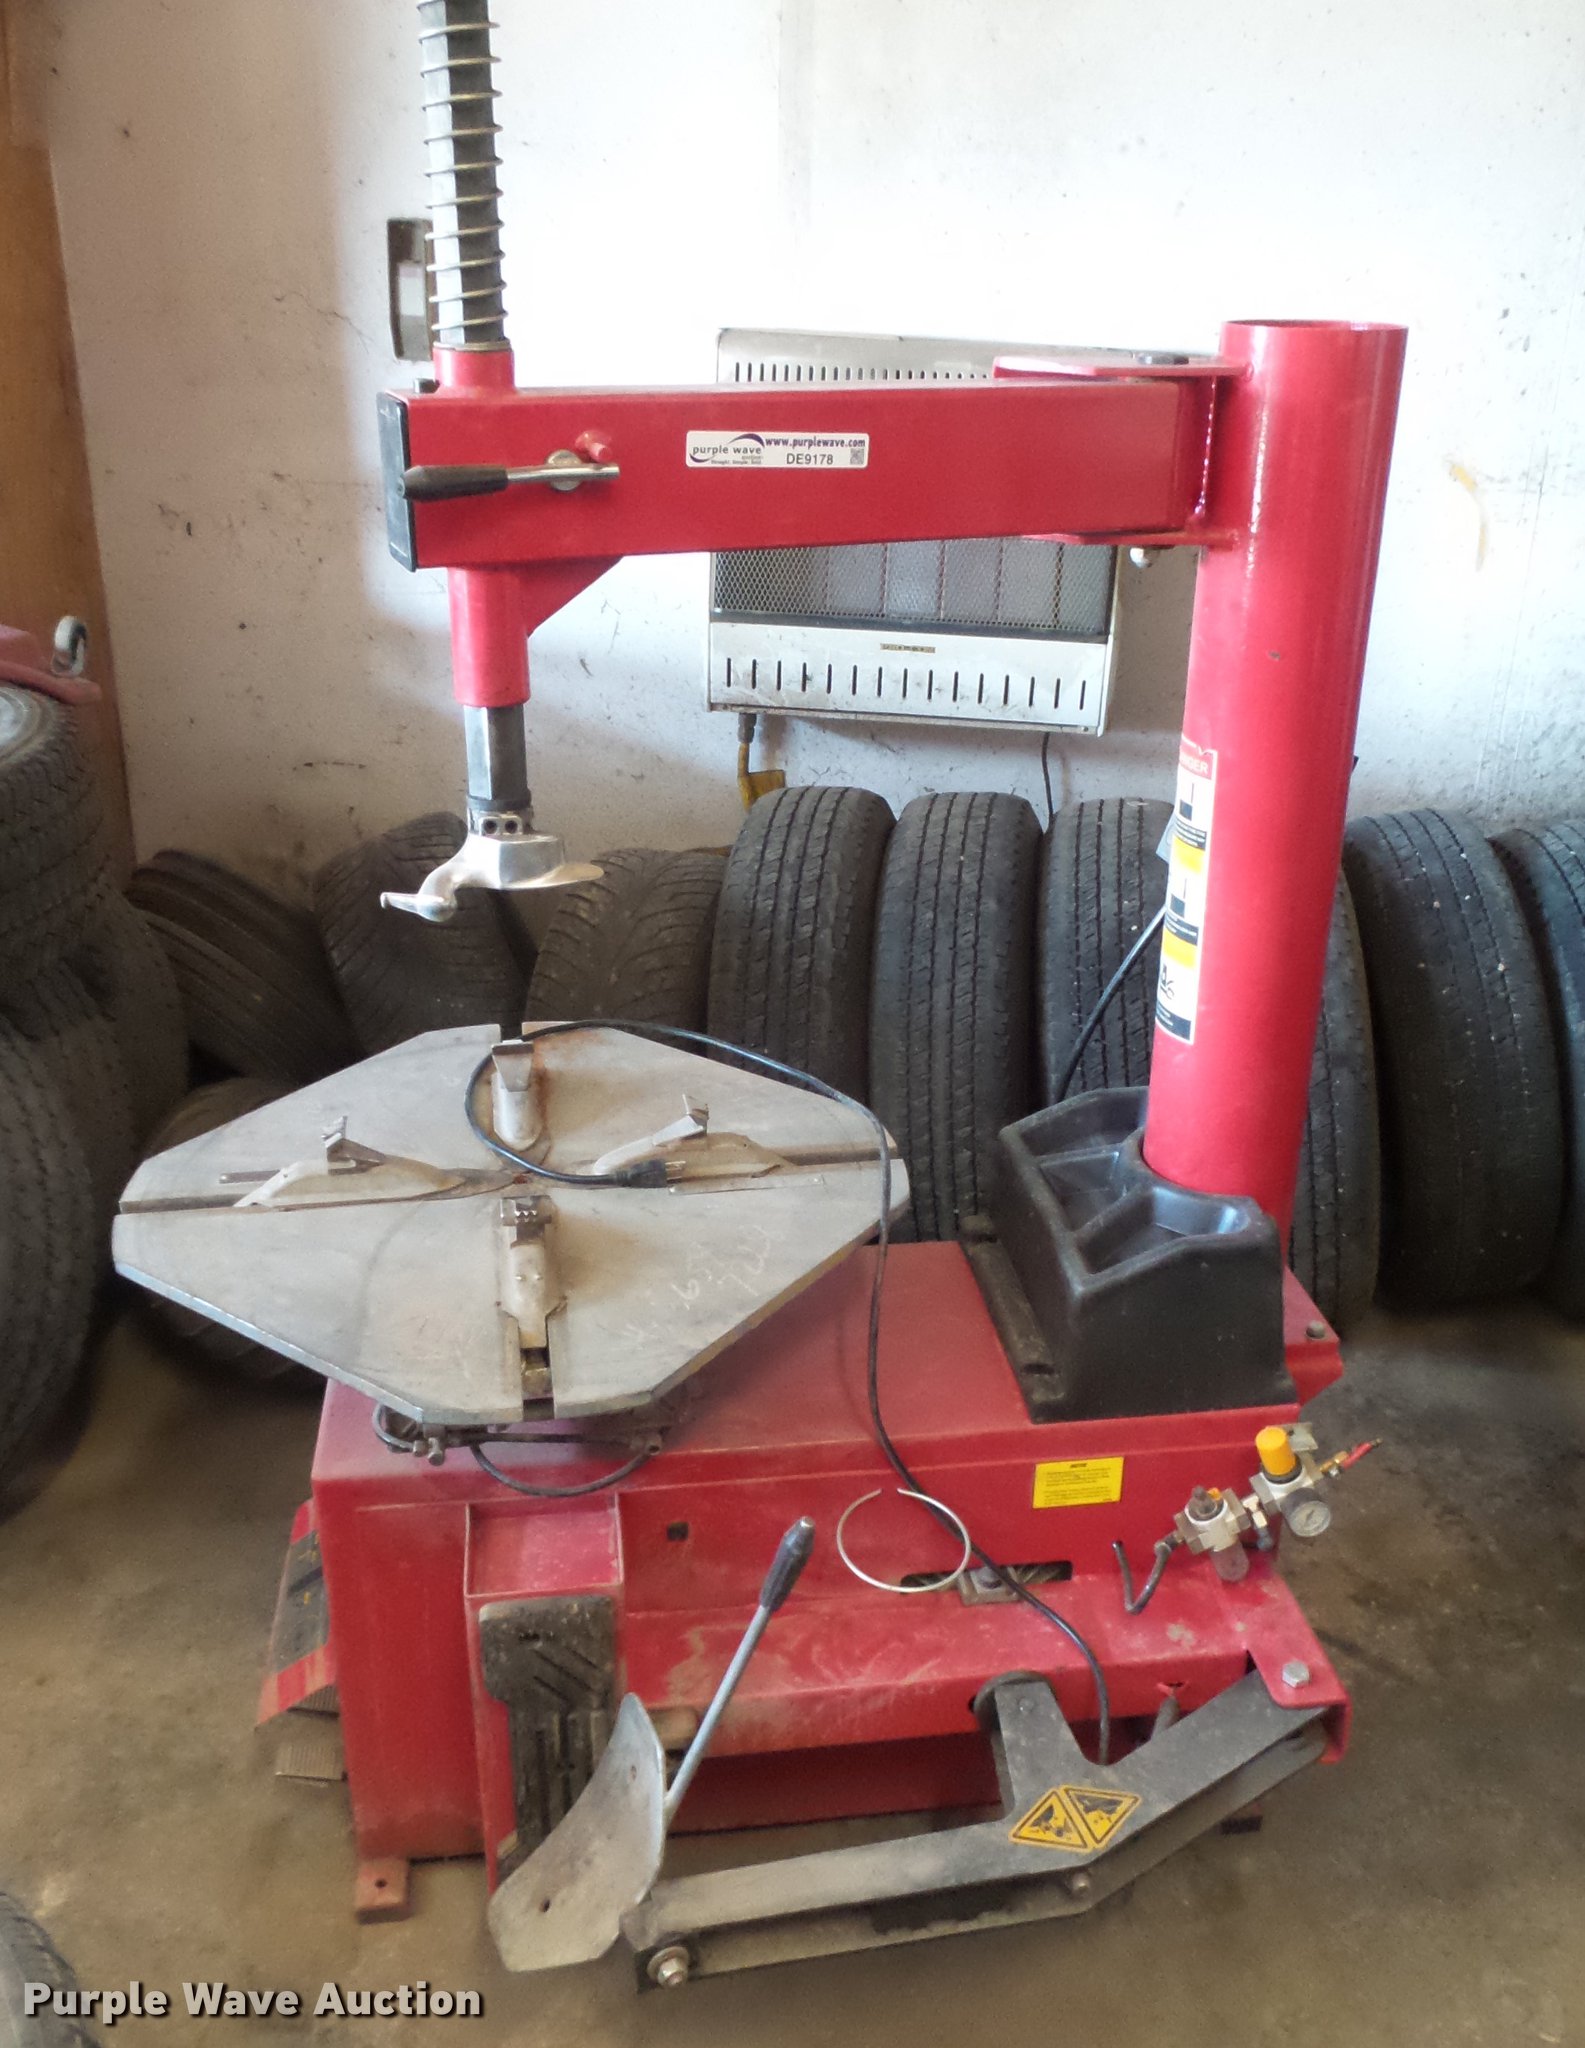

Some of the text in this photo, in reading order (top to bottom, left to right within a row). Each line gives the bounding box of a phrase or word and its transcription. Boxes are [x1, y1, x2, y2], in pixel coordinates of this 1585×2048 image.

[765, 435, 865, 450] www.purplewave.com
[692, 445, 762, 455] purple wave
[786, 452, 834, 465] DE9178
